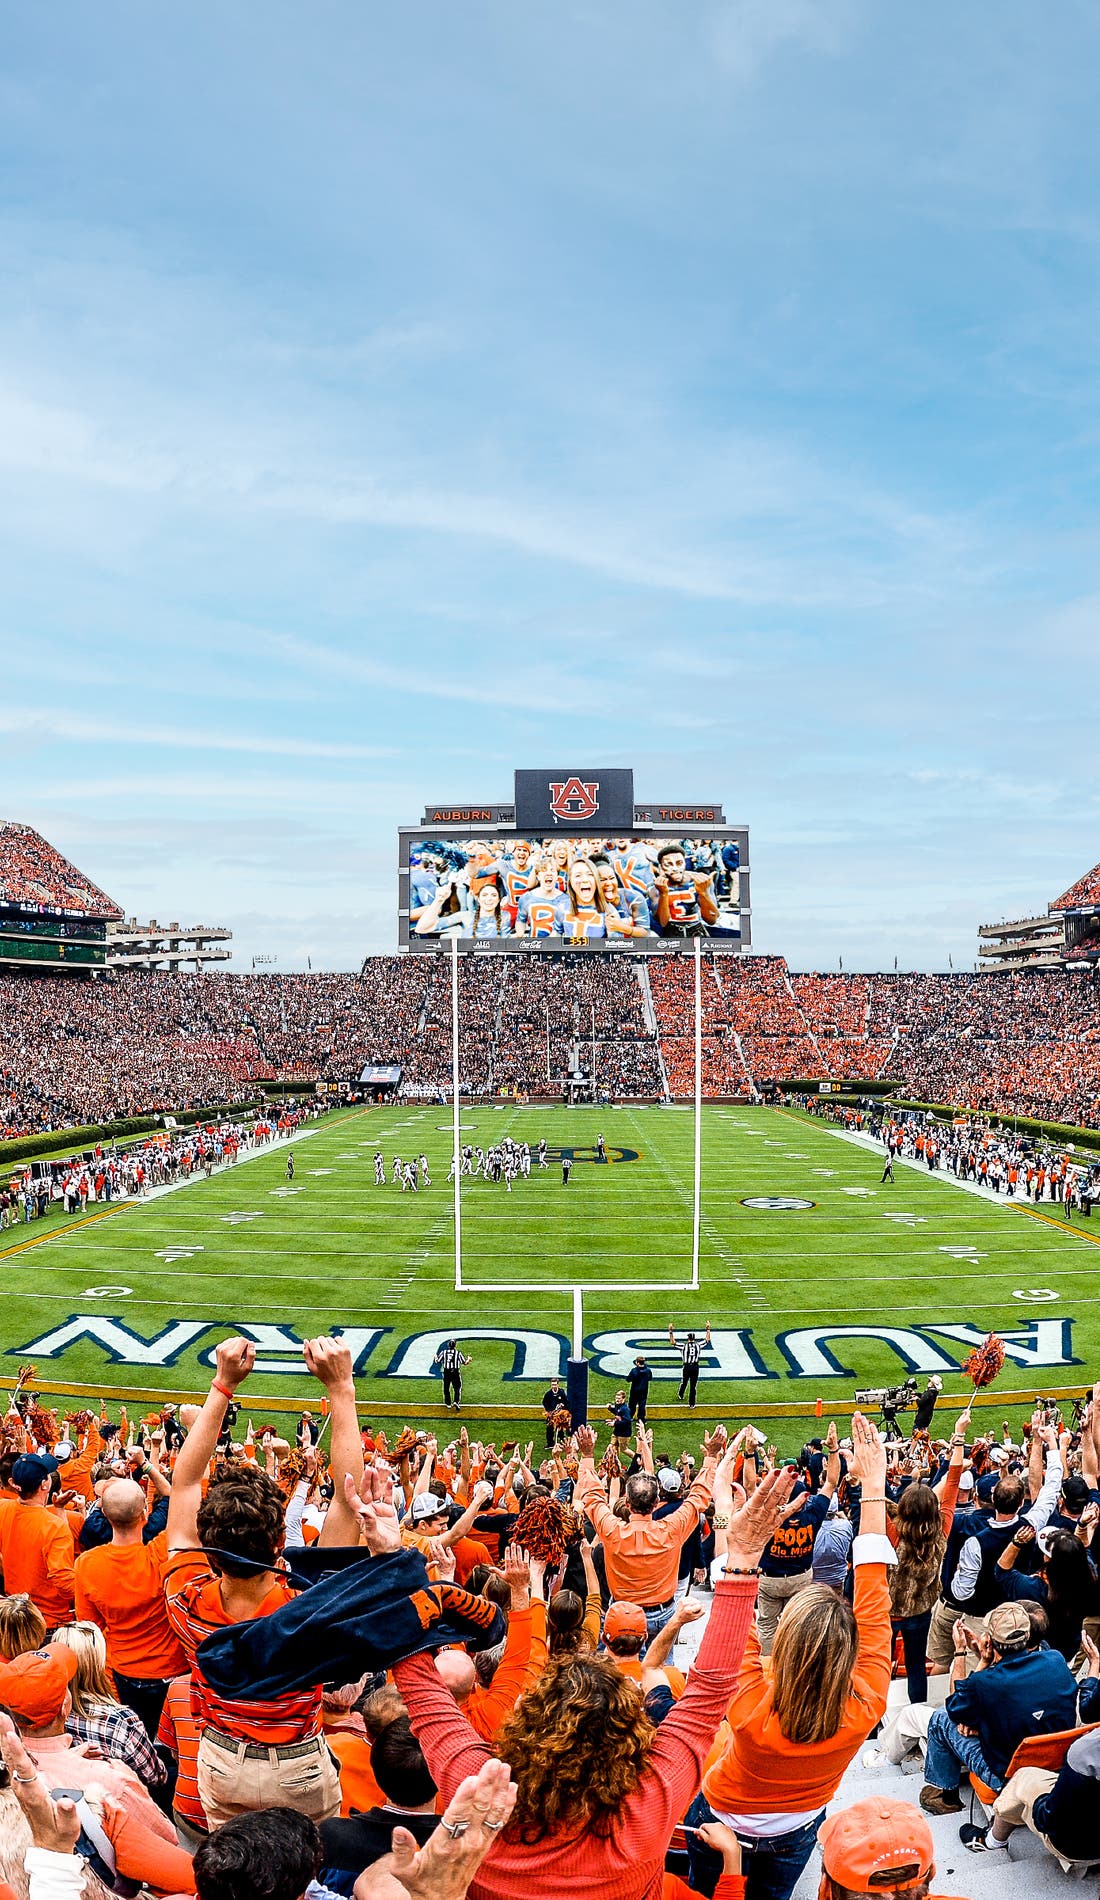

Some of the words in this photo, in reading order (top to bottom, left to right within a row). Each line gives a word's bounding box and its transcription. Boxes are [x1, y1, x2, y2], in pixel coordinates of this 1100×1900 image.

[432, 809, 492, 821] AUBURN
[659, 809, 715, 821] TIGERS
[613, 856, 647, 893] K
[667, 889, 699, 922] E
[564, 911, 605, 938] T
[569, 935, 589, 947] 3:53
[79, 1285, 134, 1298] G
[1011, 1287, 1061, 1301] G
[447, 1353, 454, 1362] F
[689, 1347, 696, 1356] B
